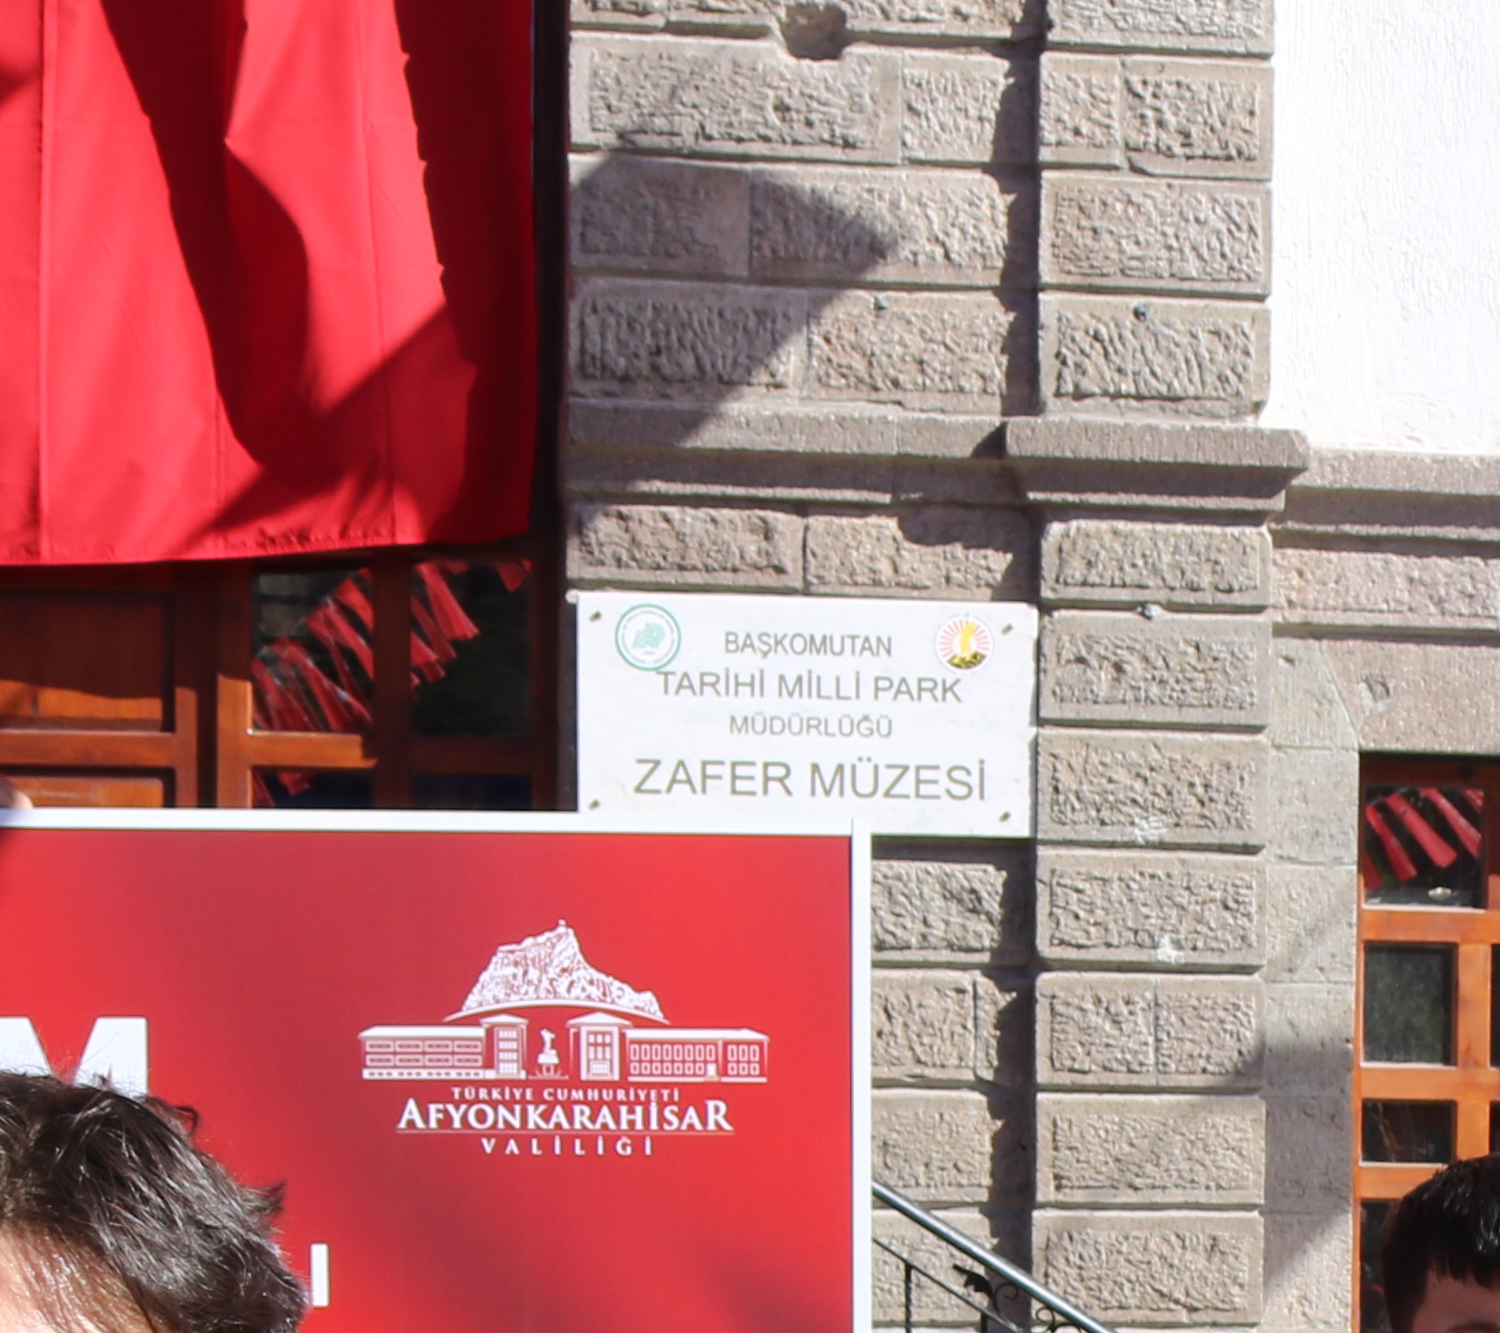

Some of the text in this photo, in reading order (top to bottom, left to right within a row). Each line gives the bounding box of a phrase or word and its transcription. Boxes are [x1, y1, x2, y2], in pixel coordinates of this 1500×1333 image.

[725, 632, 891, 659] BAŞKOMUTAN
[659, 668, 962, 704] TARİHİ MİLLİ PARK
[729, 712, 892, 738] MÜDÜRLÜĞÜ
[634, 756, 986, 801] ZAFER MÜZESİ
[452, 1086, 680, 1101] TÜRKİYE CUMHURİYETİ
[397, 1097, 735, 1131] AFYONKARAHİSAR
[482, 1135, 654, 1156] VALİLİĞİ
